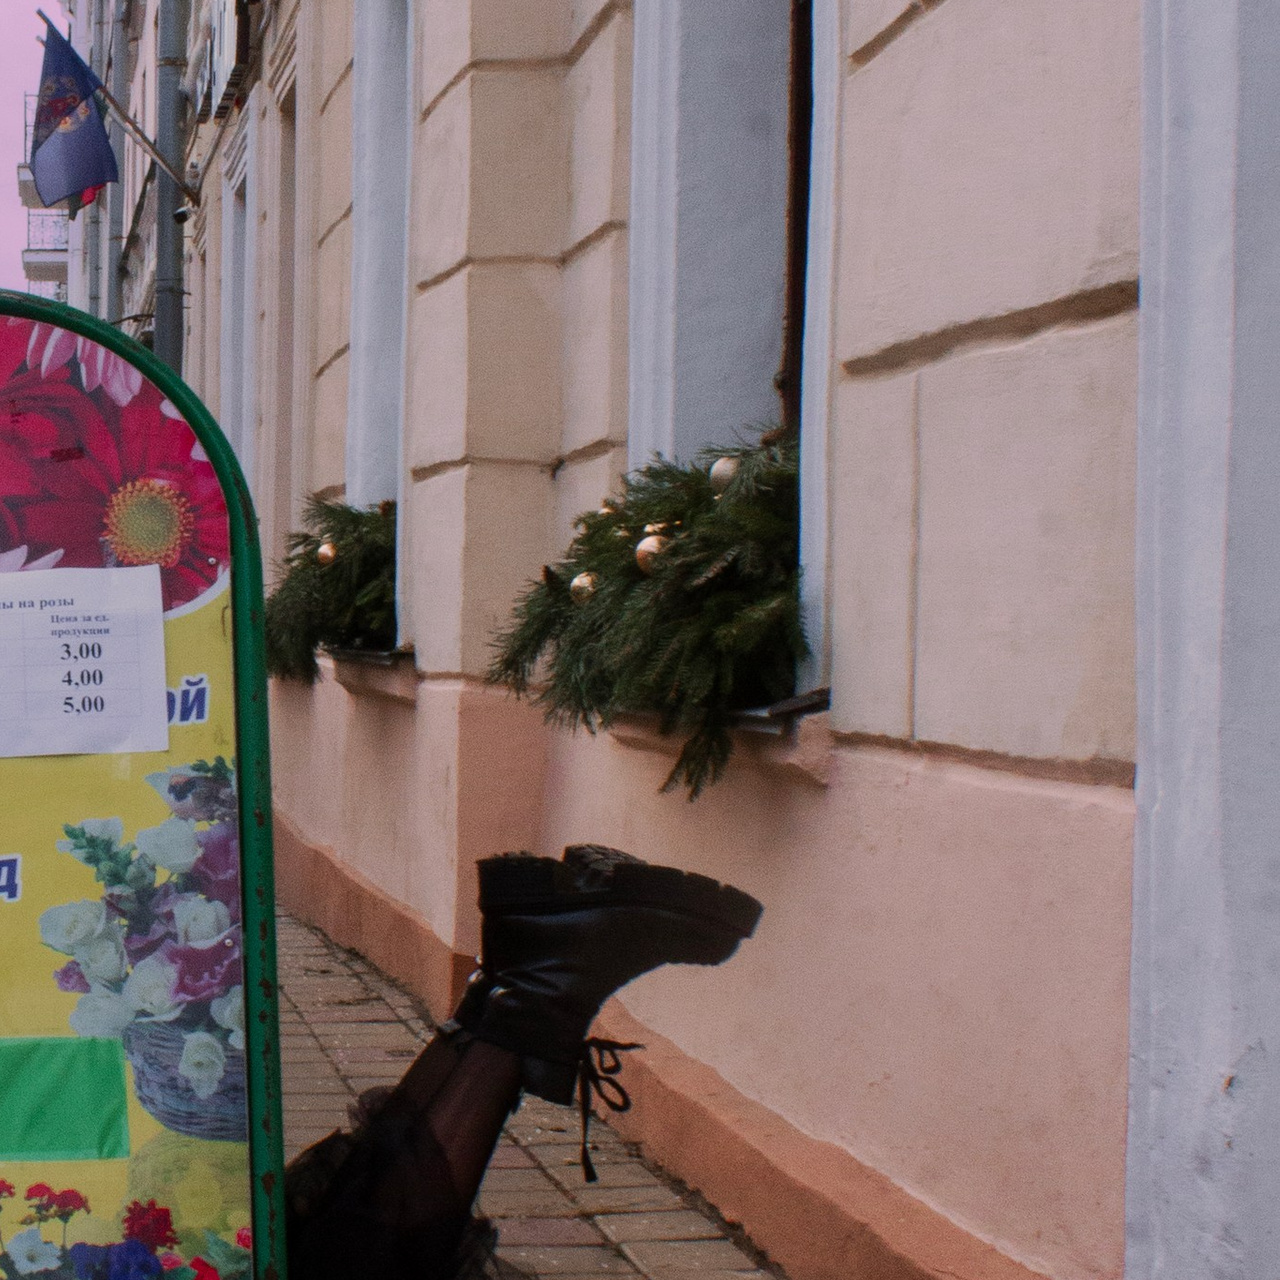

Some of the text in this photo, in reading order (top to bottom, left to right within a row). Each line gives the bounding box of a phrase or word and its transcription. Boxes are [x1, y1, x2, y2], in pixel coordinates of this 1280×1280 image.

[18, 600, 35, 609] на
[40, 598, 75, 611] розы
[50, 614, 79, 624] Цена
[51, 627, 111, 639] продукции
[60, 641, 102, 663] 3,00
[61, 668, 103, 689] 4,00
[62, 695, 105, 716] 5,00
